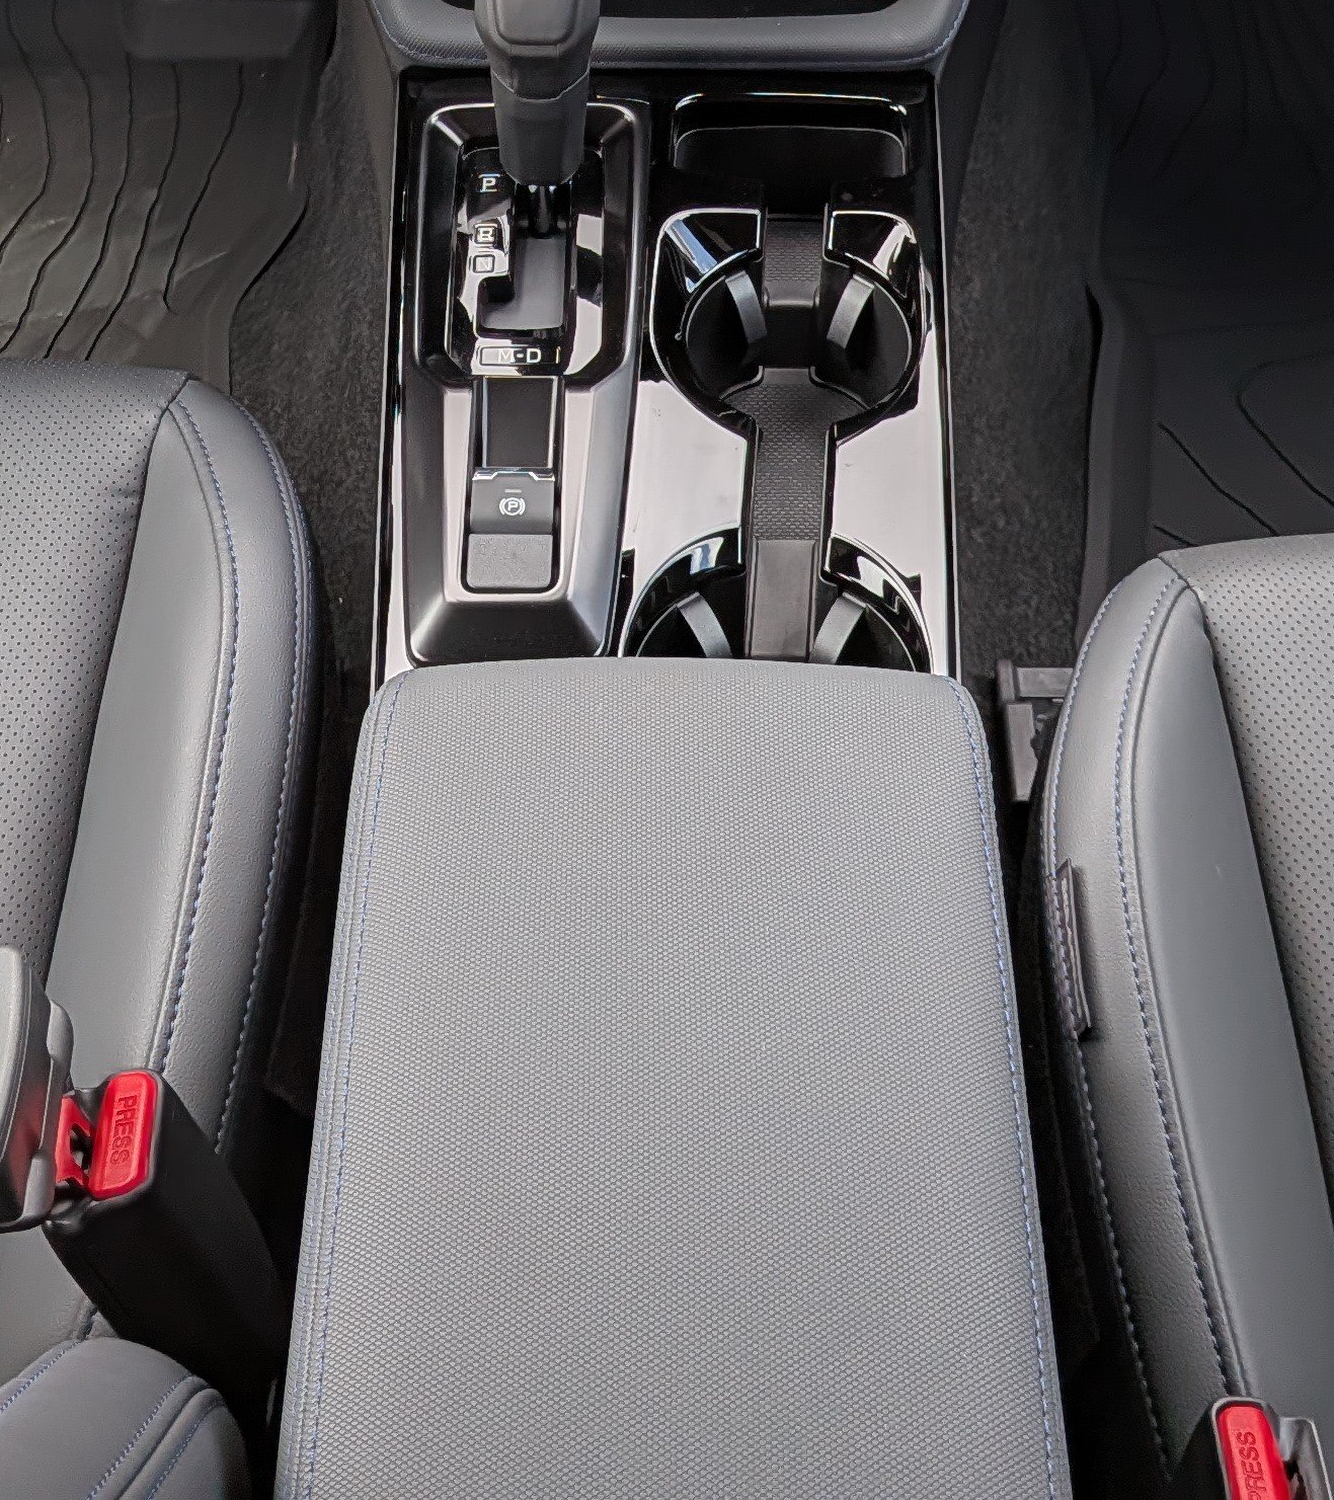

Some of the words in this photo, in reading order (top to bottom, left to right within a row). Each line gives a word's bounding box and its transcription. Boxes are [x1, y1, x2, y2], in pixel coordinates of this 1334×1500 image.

[481, 177, 497, 191] P
[479, 257, 493, 271] N
[109, 1093, 138, 1165] PRESS
